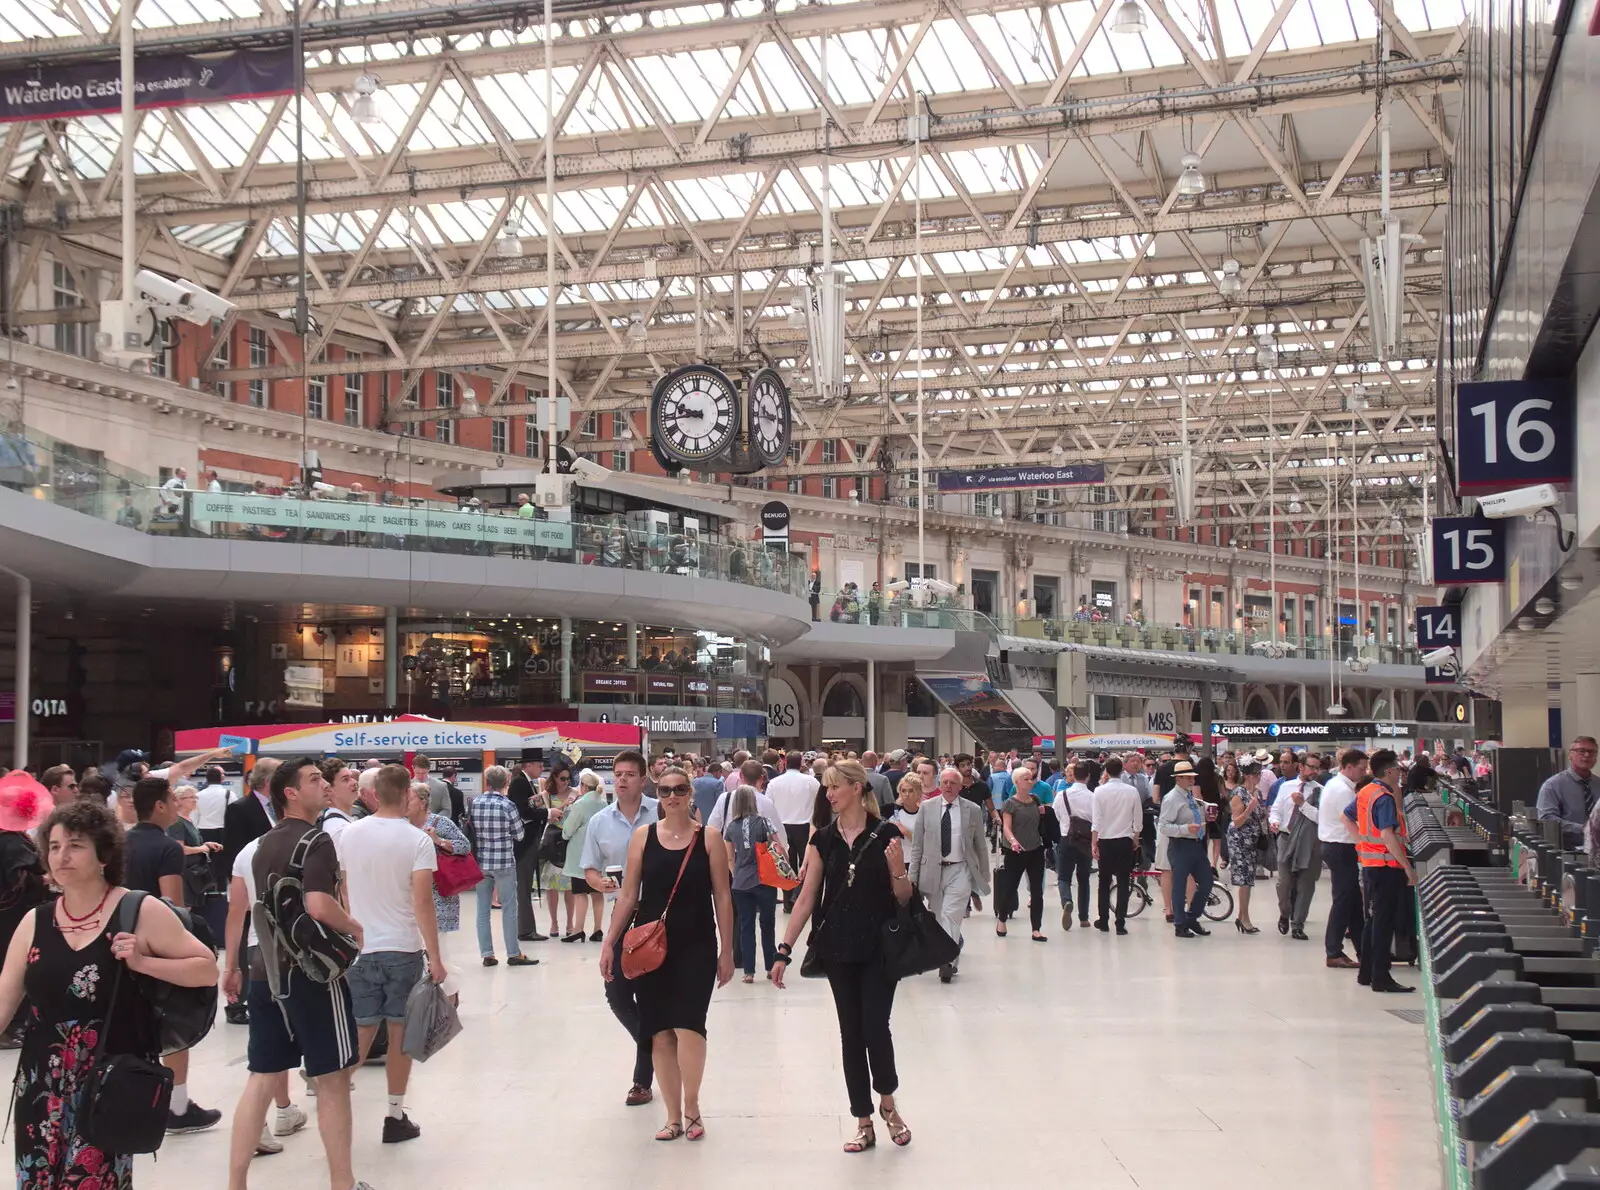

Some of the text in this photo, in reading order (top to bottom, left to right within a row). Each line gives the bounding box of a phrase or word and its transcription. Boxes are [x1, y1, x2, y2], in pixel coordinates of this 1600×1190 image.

[5, 82, 82, 105] Waterloo
[86, 78, 122, 98] East
[147, 77, 192, 91] escalator
[1471, 398, 1556, 464] 16
[1018, 471, 1055, 481] Waterloo
[1056, 470, 1074, 479] East
[1482, 497, 1507, 507] PHILIPS
[206, 503, 234, 513] COFFEE
[242, 505, 277, 516] PASTRIES
[285, 508, 298, 517] TEA
[306, 510, 351, 521] SANDWICHES
[358, 514, 376, 523] JUICE
[383, 516, 419, 527] BAGUETTES
[425, 519, 446, 529] WRAPS
[452, 522, 471, 531] CAKES
[477, 524, 499, 533] SALADS
[504, 527, 517, 535] BEER
[541, 530, 551, 539] HOT
[551, 531, 564, 540] FOOD
[763, 511, 788, 519] BENUGO
[1443, 528, 1495, 571] 15
[1421, 613, 1456, 640] 14
[32, 699, 68, 717] OSTA
[652, 716, 696, 732] information
[1148, 711, 1174, 731] M&S
[335, 731, 487, 746] Self-service tickets
[1222, 726, 1268, 734] CURRENCY
[1282, 726, 1329, 734] EXCHANGE
[1089, 737, 1157, 745] Self-service tickets
